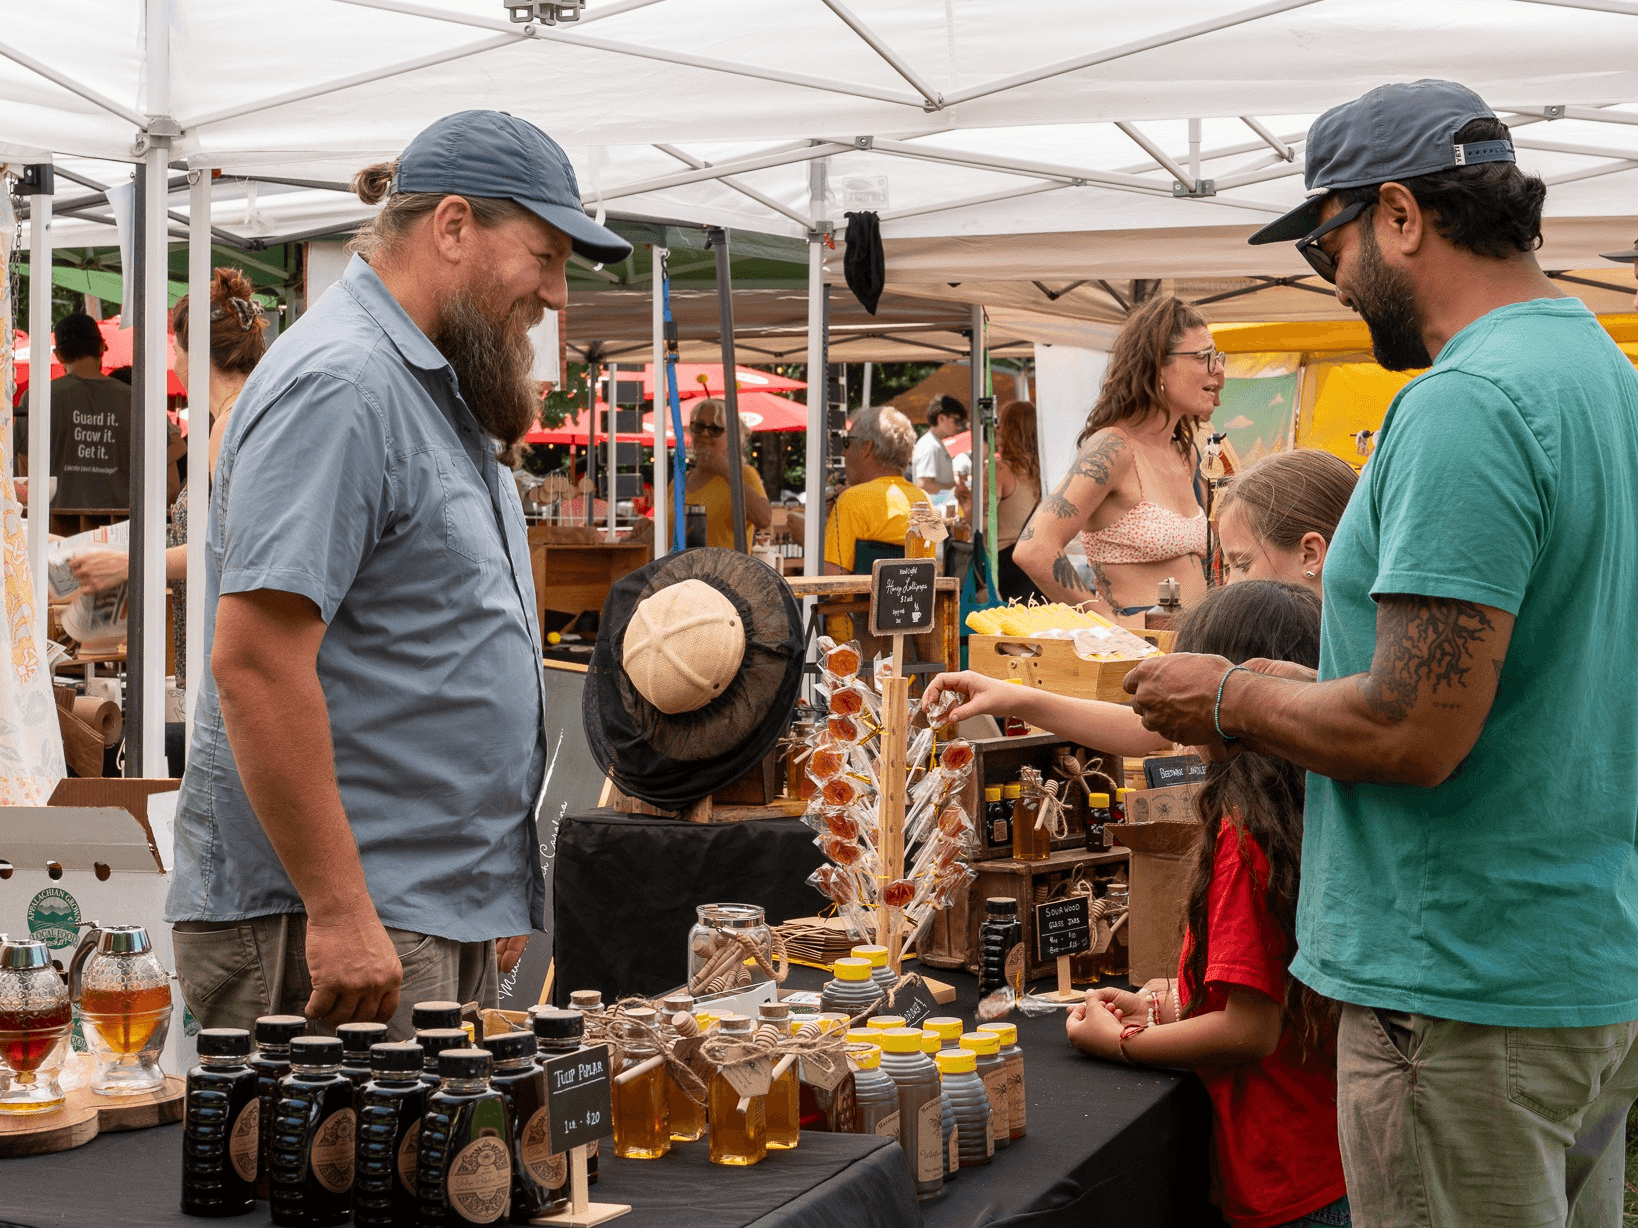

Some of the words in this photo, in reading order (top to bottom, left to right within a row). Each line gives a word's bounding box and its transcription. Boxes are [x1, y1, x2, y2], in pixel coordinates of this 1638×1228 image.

[1454, 145, 1462, 163] YETI
[73, 410, 104, 426] Guard
[107, 412, 119, 426] it.
[74, 427, 101, 442] Grow
[103, 429, 115, 443] it.
[78, 444, 95, 459] Get
[97, 445, 109, 460] it.
[886, 578, 902, 597] Honey
[28, 888, 65, 921] APPALACHIAN
[65, 894, 81, 922] GROWN
[1048, 920, 1064, 930] GLASS
[31, 929, 57, 941] LOCAL
[57, 929, 78, 943] FOOD
[70, 1036, 88, 1049] OOD
[554, 1068, 576, 1088] TULIP
[586, 1110, 601, 1126] $20
